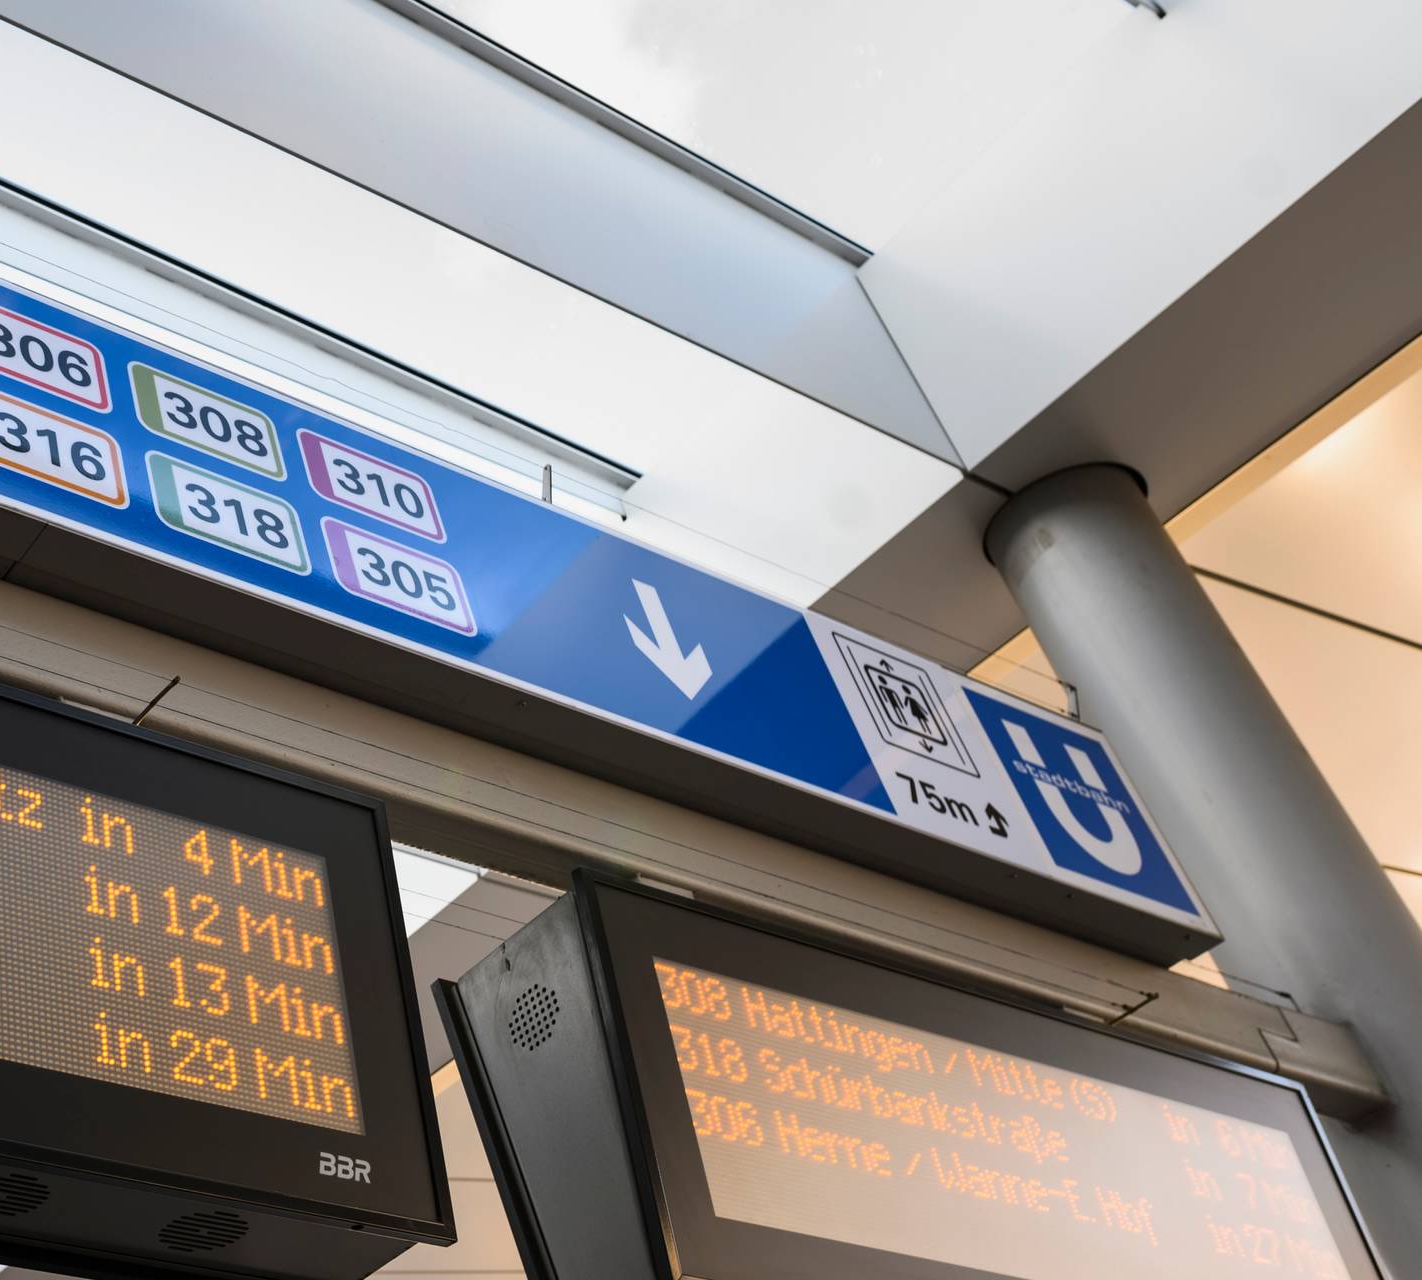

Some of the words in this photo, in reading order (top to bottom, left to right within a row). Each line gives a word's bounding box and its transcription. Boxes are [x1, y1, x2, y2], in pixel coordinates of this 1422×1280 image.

[163, 391, 268, 458] 308
[184, 482, 290, 549] 318
[332, 458, 425, 520] 310
[356, 546, 457, 612] 305
[894, 771, 980, 827] 75m
[1012, 759, 1131, 814] stadtbahn
[80, 796, 134, 855] in
[183, 829, 215, 876] 4
[230, 836, 324, 907] Min
[84, 864, 140, 924] in
[162, 885, 223, 946] 12
[237, 905, 334, 975] Min
[89, 937, 145, 997] in
[169, 956, 231, 1016] 13
[245, 974, 344, 1045] Min
[94, 1011, 152, 1073] in
[169, 1029, 238, 1091] 29
[254, 1047, 355, 1118] Min
[655, 962, 732, 1021] 308
[741, 986, 935, 1074] Hattingen
[966, 1048, 1065, 1111] Mitte
[1069, 1077, 1117, 1123] (S)
[668, 1024, 749, 1083] 318
[757, 1047, 1070, 1165] Schürbankstraße
[685, 1087, 765, 1147] 306
[773, 1109, 894, 1177] Herne
[319, 1151, 372, 1184] BBR
